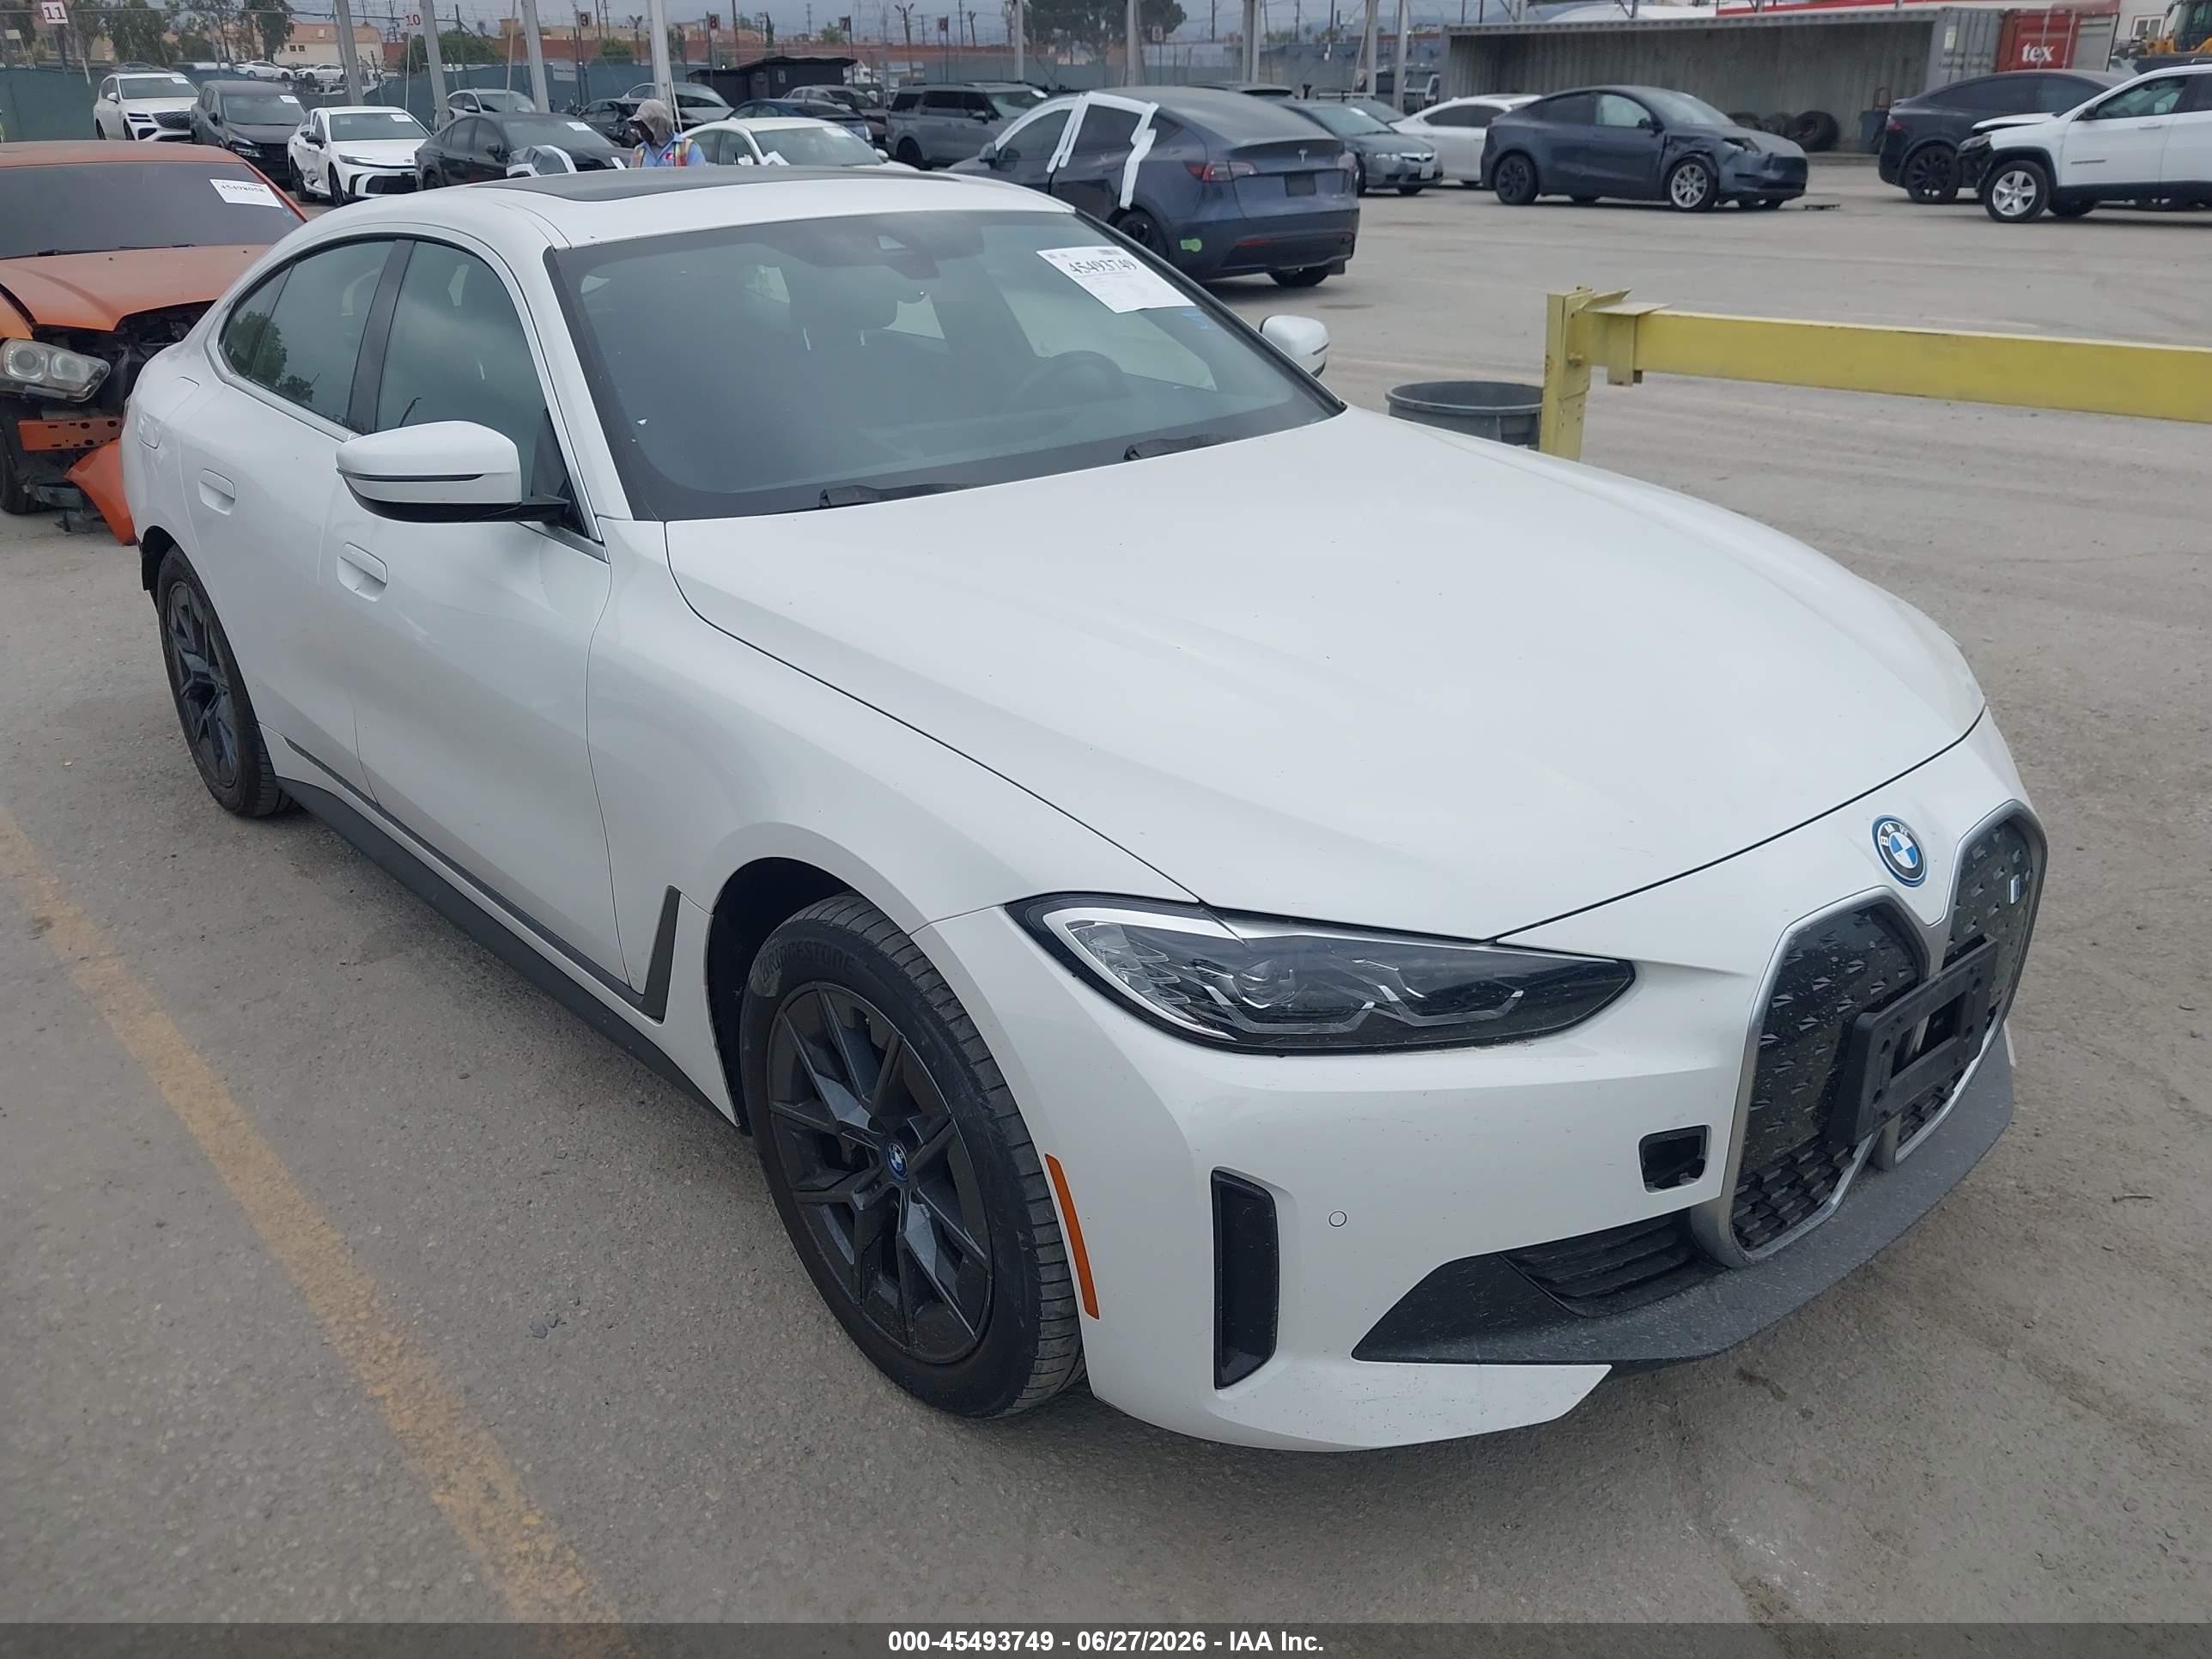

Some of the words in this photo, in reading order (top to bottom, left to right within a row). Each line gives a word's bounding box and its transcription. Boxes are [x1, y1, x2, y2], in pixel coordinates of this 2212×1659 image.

[44, 7, 66, 20] 11
[405, 14, 421, 26] 10
[580, 14, 589, 27] 9
[2021, 42, 2055, 63] tex
[1068, 259, 1138, 274] 45493749
[1881, 823, 1908, 847] BMW
